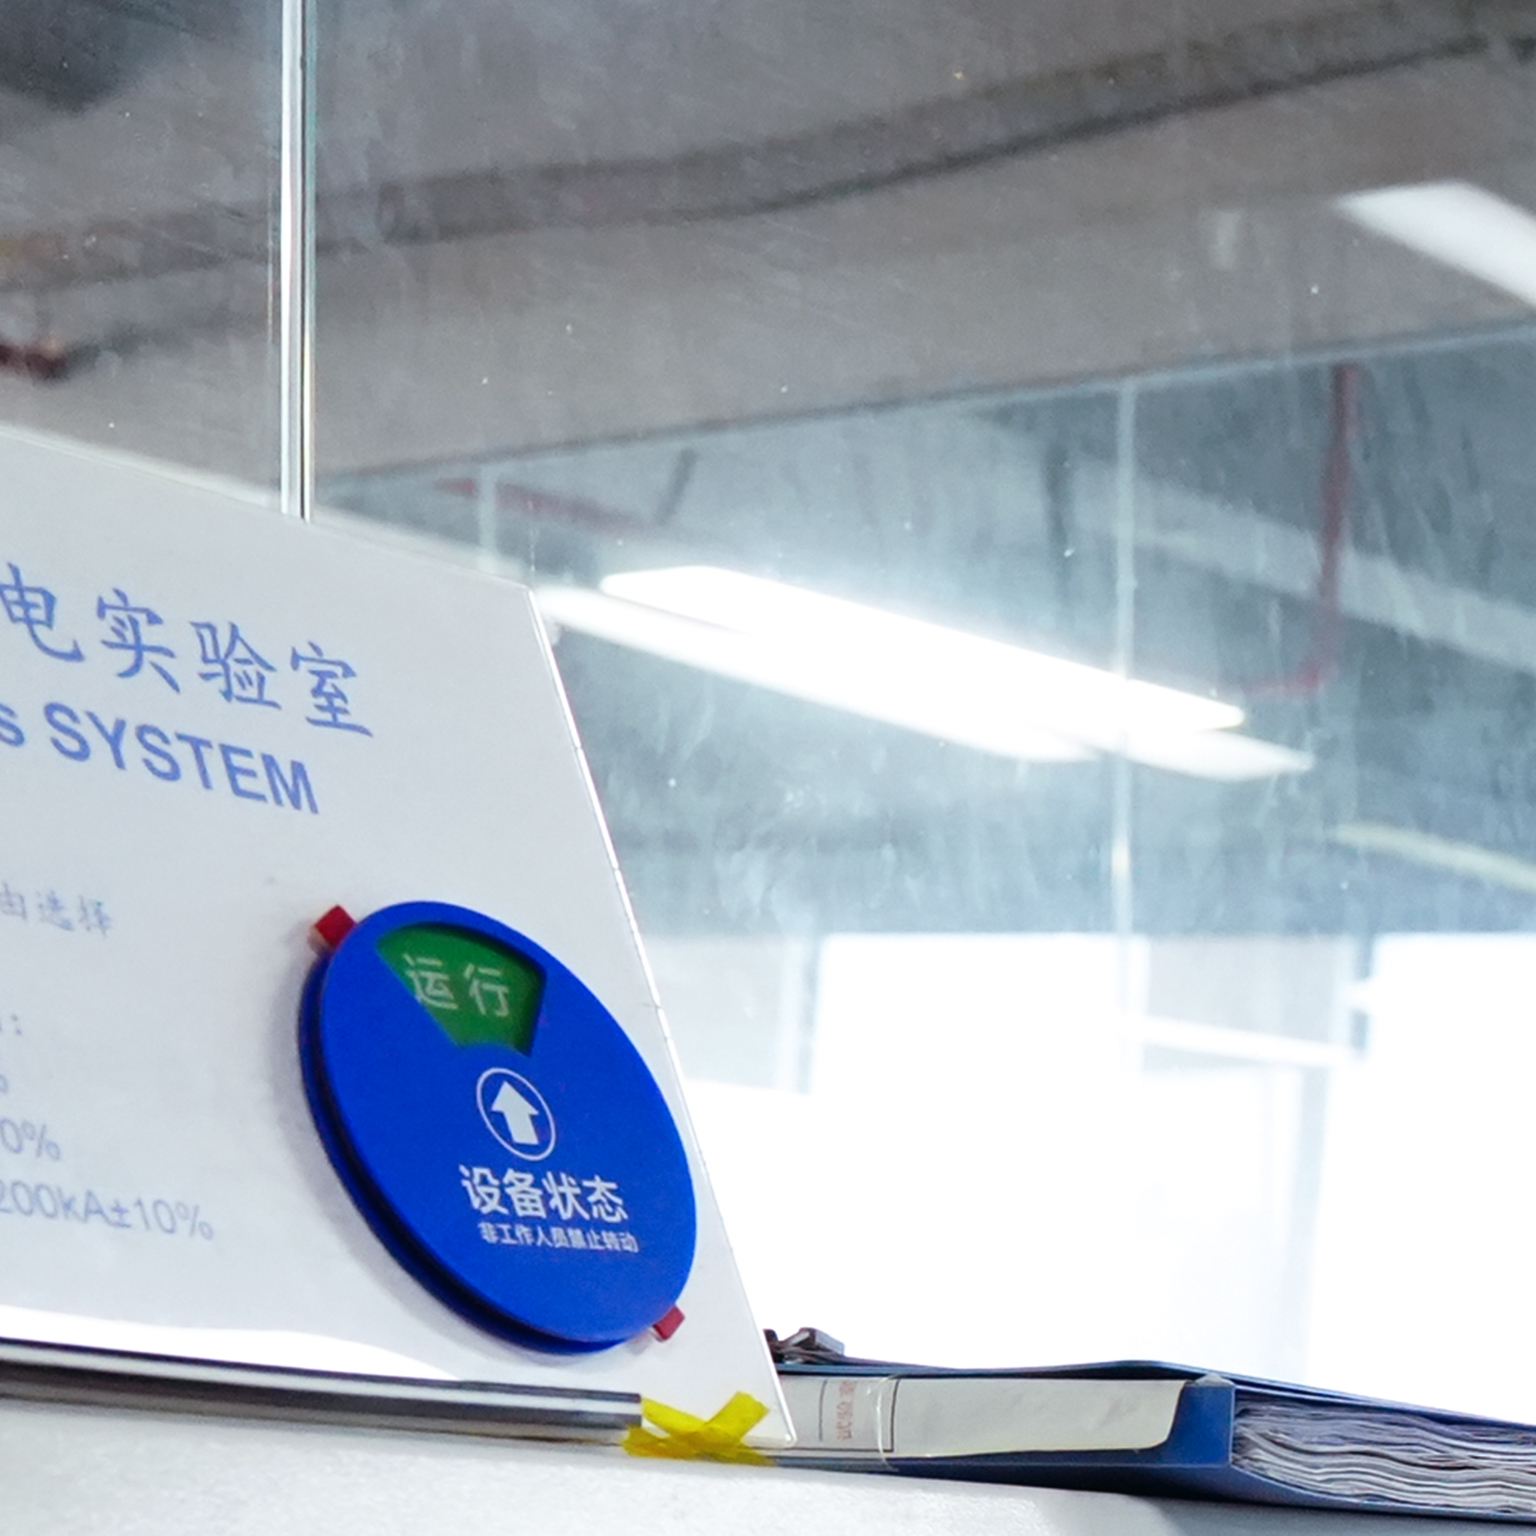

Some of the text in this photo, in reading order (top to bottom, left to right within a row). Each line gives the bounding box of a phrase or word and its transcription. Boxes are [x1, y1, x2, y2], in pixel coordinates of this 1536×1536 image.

[0, 562, 373, 737] 电实验室
[43, 701, 320, 815] SYSTEM
[403, 952, 510, 1018] 运行
[457, 1163, 630, 1224] 设备状态
[477, 1221, 640, 1254] 非工作人员禁止转动
